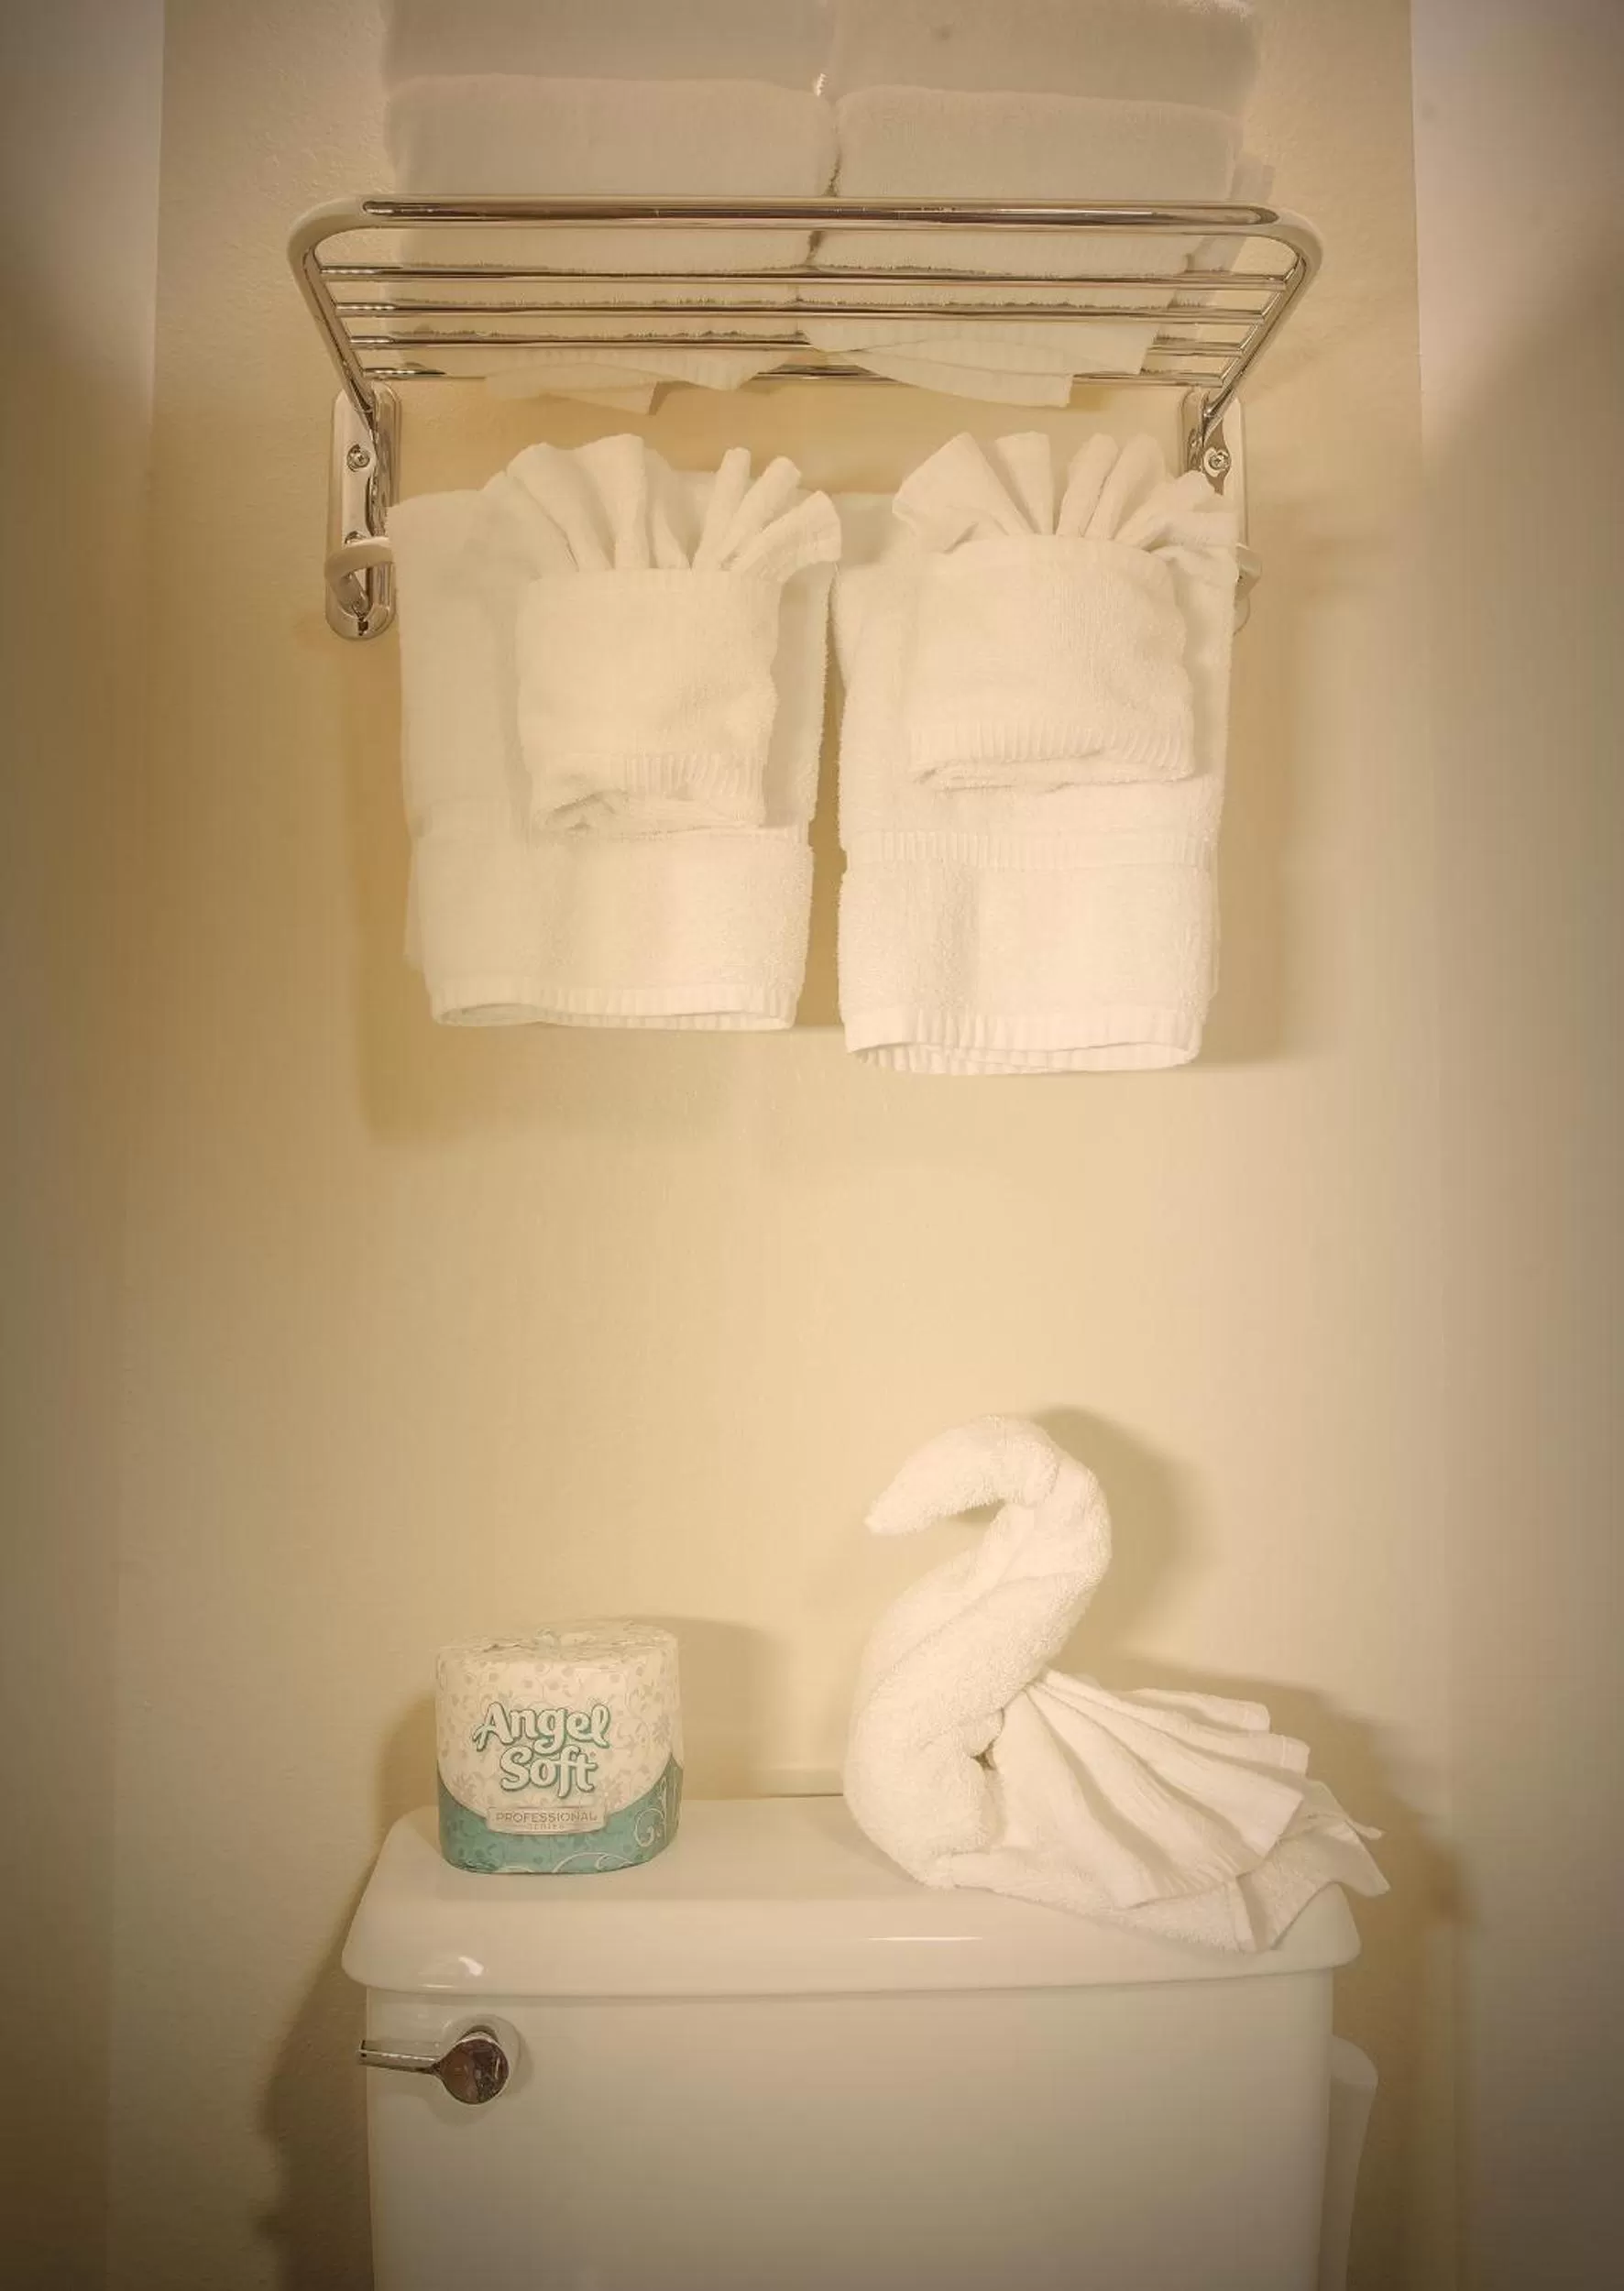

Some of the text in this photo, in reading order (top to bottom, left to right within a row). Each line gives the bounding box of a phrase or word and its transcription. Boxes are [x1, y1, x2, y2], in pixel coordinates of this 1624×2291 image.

[472, 1701, 610, 1756] Angel
[500, 1746, 598, 1799] Soft
[495, 1812, 598, 1824] PROFESSIONAL
